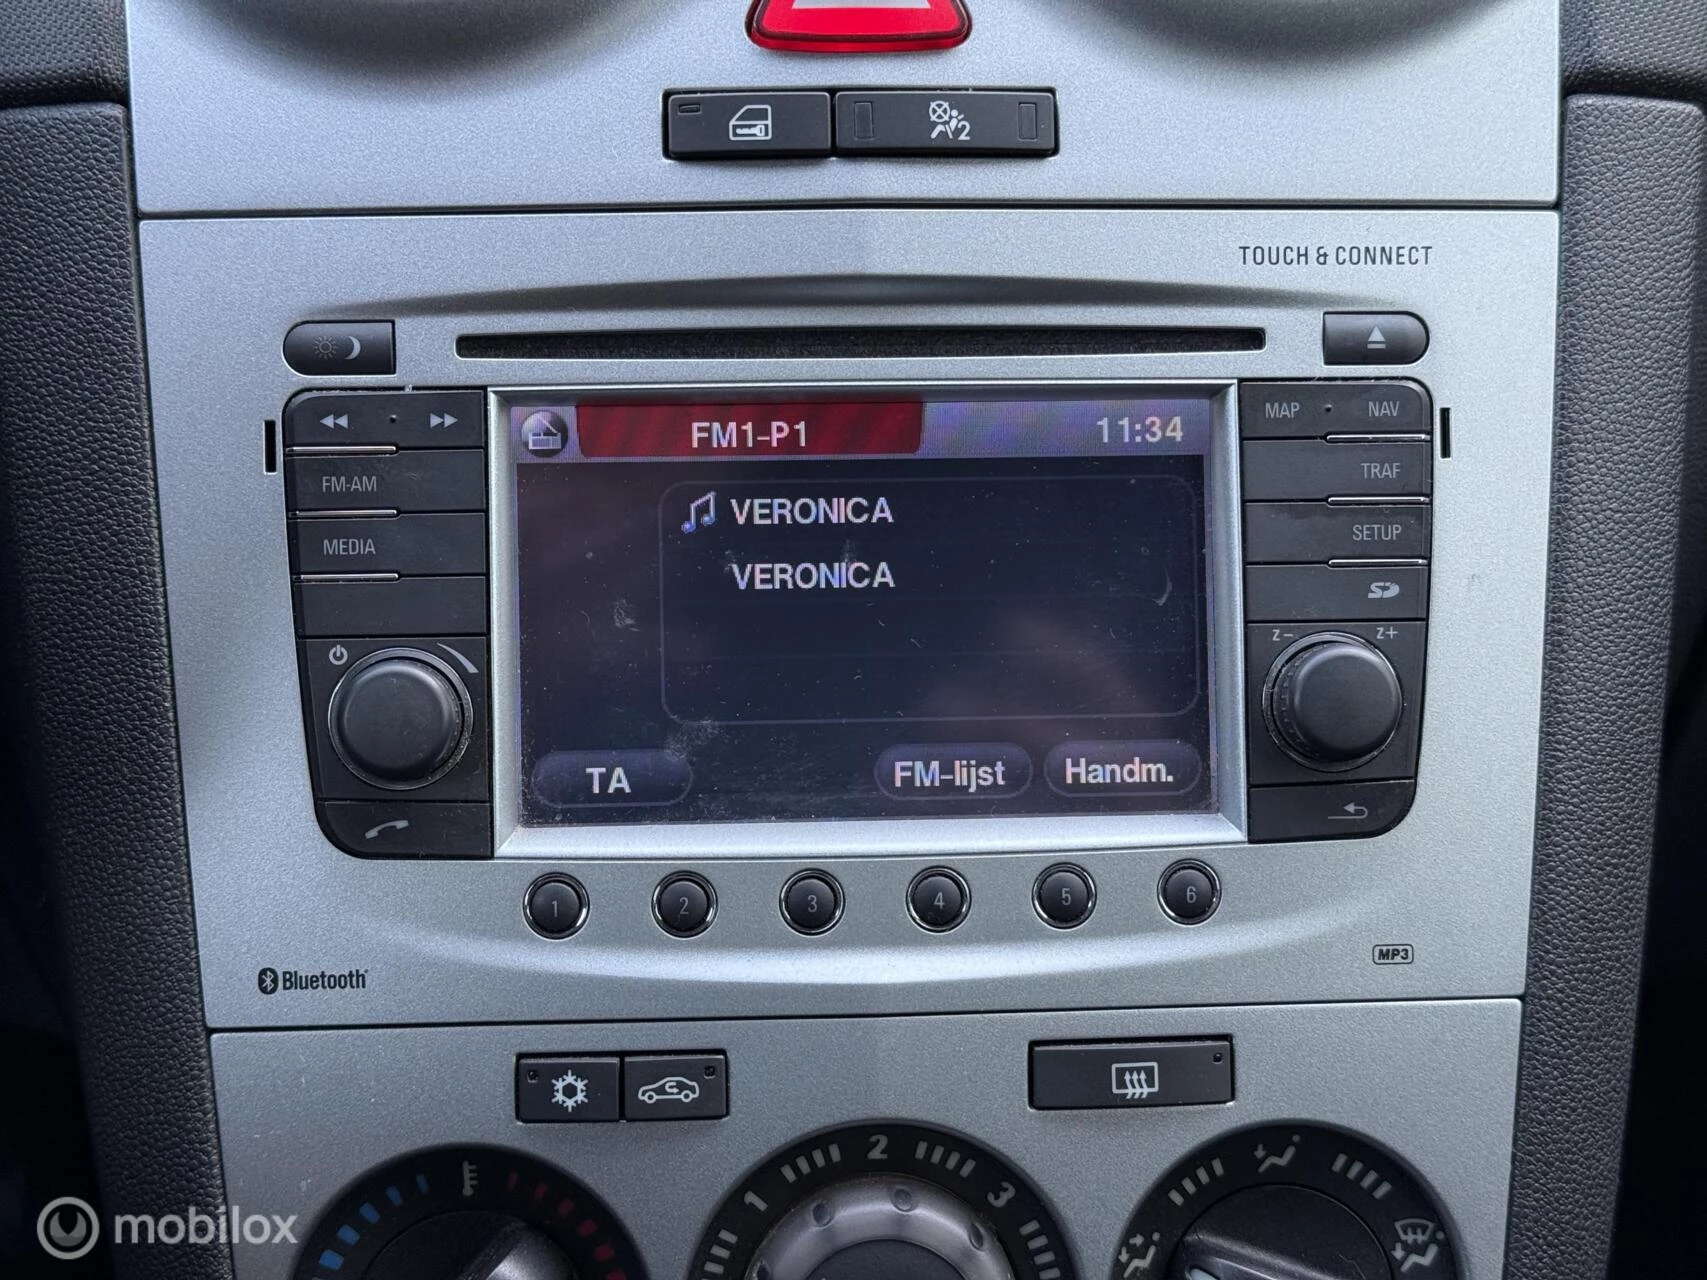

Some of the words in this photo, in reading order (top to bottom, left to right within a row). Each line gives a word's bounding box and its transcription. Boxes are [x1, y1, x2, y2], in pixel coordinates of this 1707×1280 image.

[1239, 246, 1308, 266] TOUCH
[1315, 246, 1328, 266] &
[1335, 246, 1432, 266] CONNECT
[1265, 403, 1300, 419] MAP
[1368, 402, 1400, 417] NAV
[691, 420, 807, 449] FM1-P1
[1097, 415, 1184, 444] 11:34
[1361, 463, 1401, 479] TRAF
[321, 476, 377, 494] FM-AM
[730, 496, 894, 526] VERONICA
[1352, 524, 1402, 541] SETUP
[323, 539, 376, 556] MEDIA
[731, 561, 896, 592] VERONICA
[893, 759, 1006, 793] FM-lijst
[1064, 756, 1175, 785] Handm.
[585, 766, 632, 794] TA
[933, 892, 945, 909] 4
[1061, 888, 1072, 905] 5
[1186, 885, 1197, 903] 6
[551, 900, 559, 917] 1
[679, 897, 690, 915] 2
[807, 895, 818, 913] 3
[1378, 948, 1409, 961] MP3
[866, 1134, 888, 1160] 2
[743, 1190, 769, 1212] 1
[986, 1181, 1017, 1208] 3
